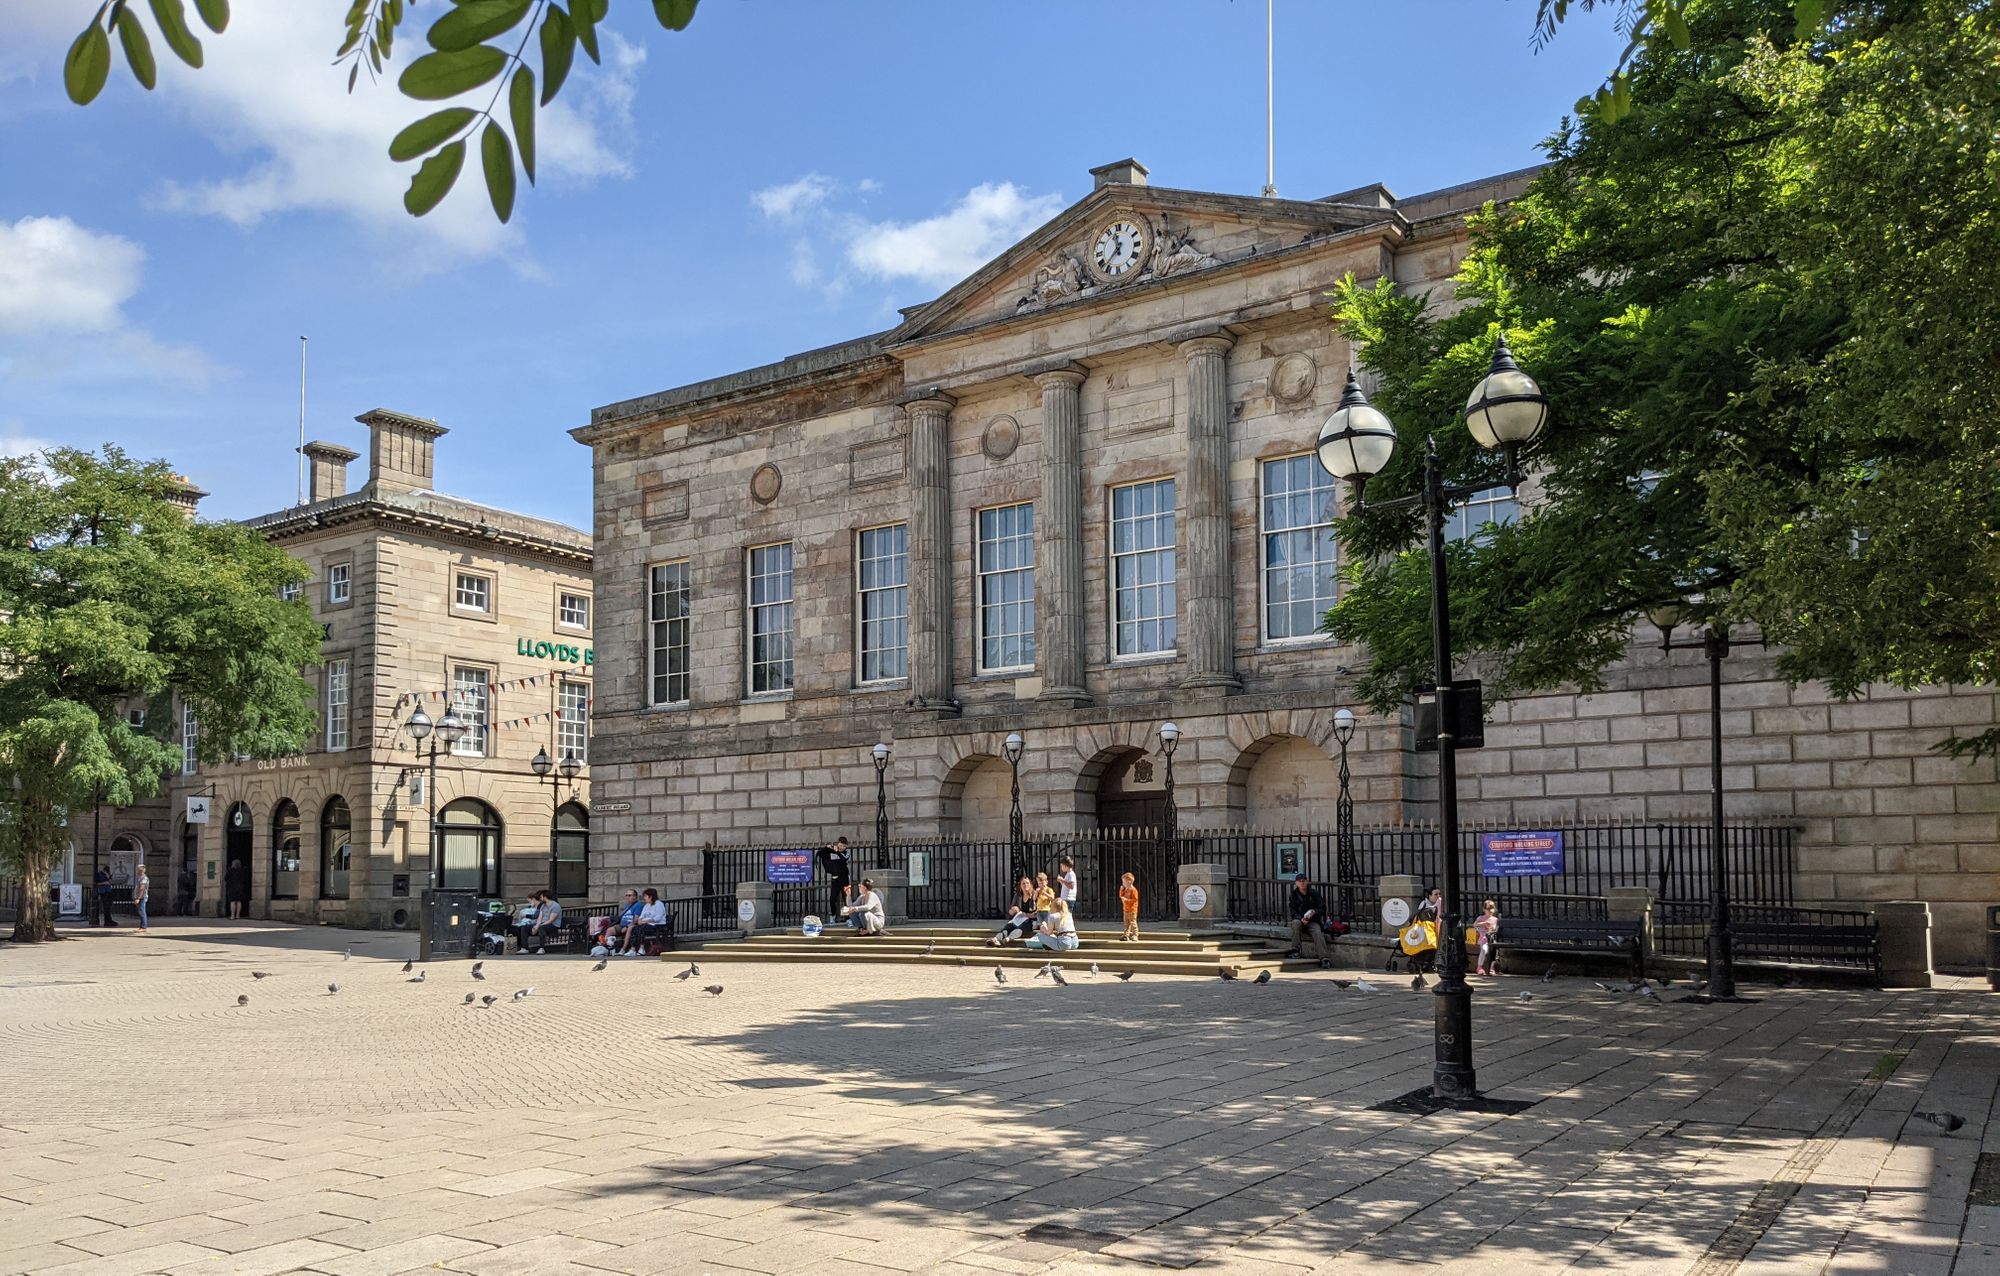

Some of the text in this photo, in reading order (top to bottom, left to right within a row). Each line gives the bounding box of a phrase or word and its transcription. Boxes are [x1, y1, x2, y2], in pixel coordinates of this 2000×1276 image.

[518, 638, 580, 663] LLOYDS
[257, 757, 310, 770] OLD BANK.
[1534, 840, 1551, 848] STREET
